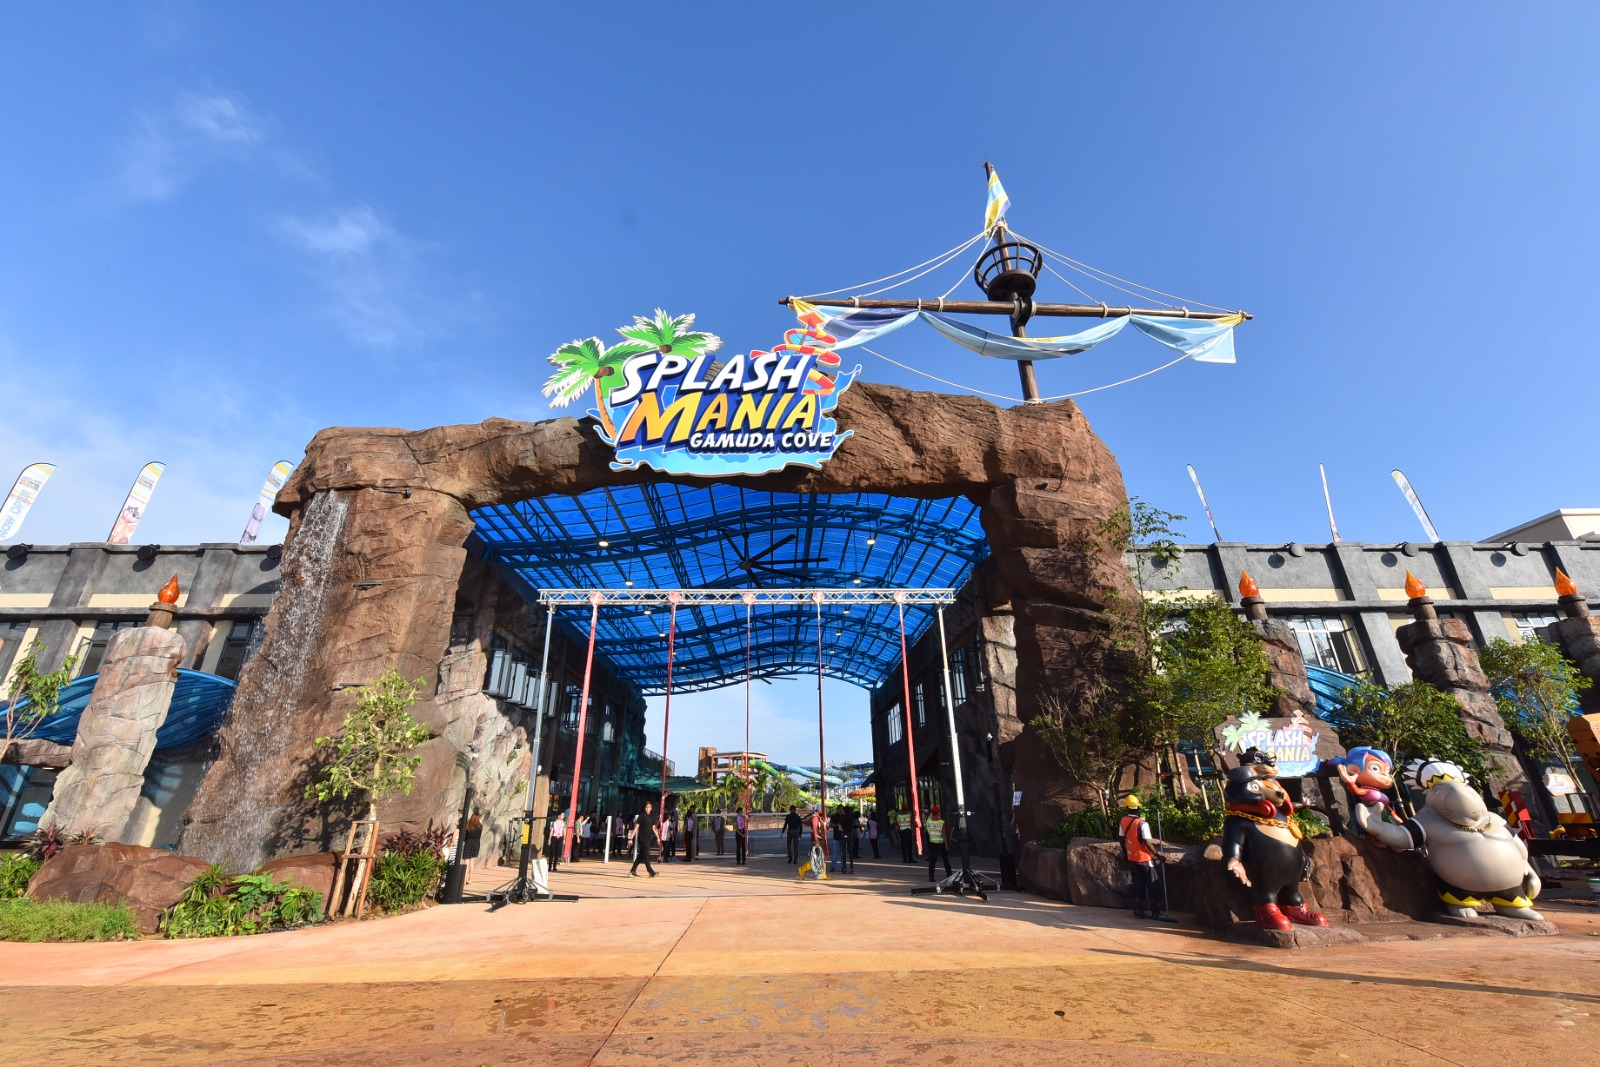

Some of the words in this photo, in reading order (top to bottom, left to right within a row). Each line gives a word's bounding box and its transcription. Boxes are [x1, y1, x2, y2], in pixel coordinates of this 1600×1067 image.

[610, 353, 810, 404] SPLASH
[619, 391, 817, 443] MANIA
[690, 432, 775, 449] GAMUDA
[782, 431, 834, 449] COVE
[1247, 729, 1303, 747] SPLASH
